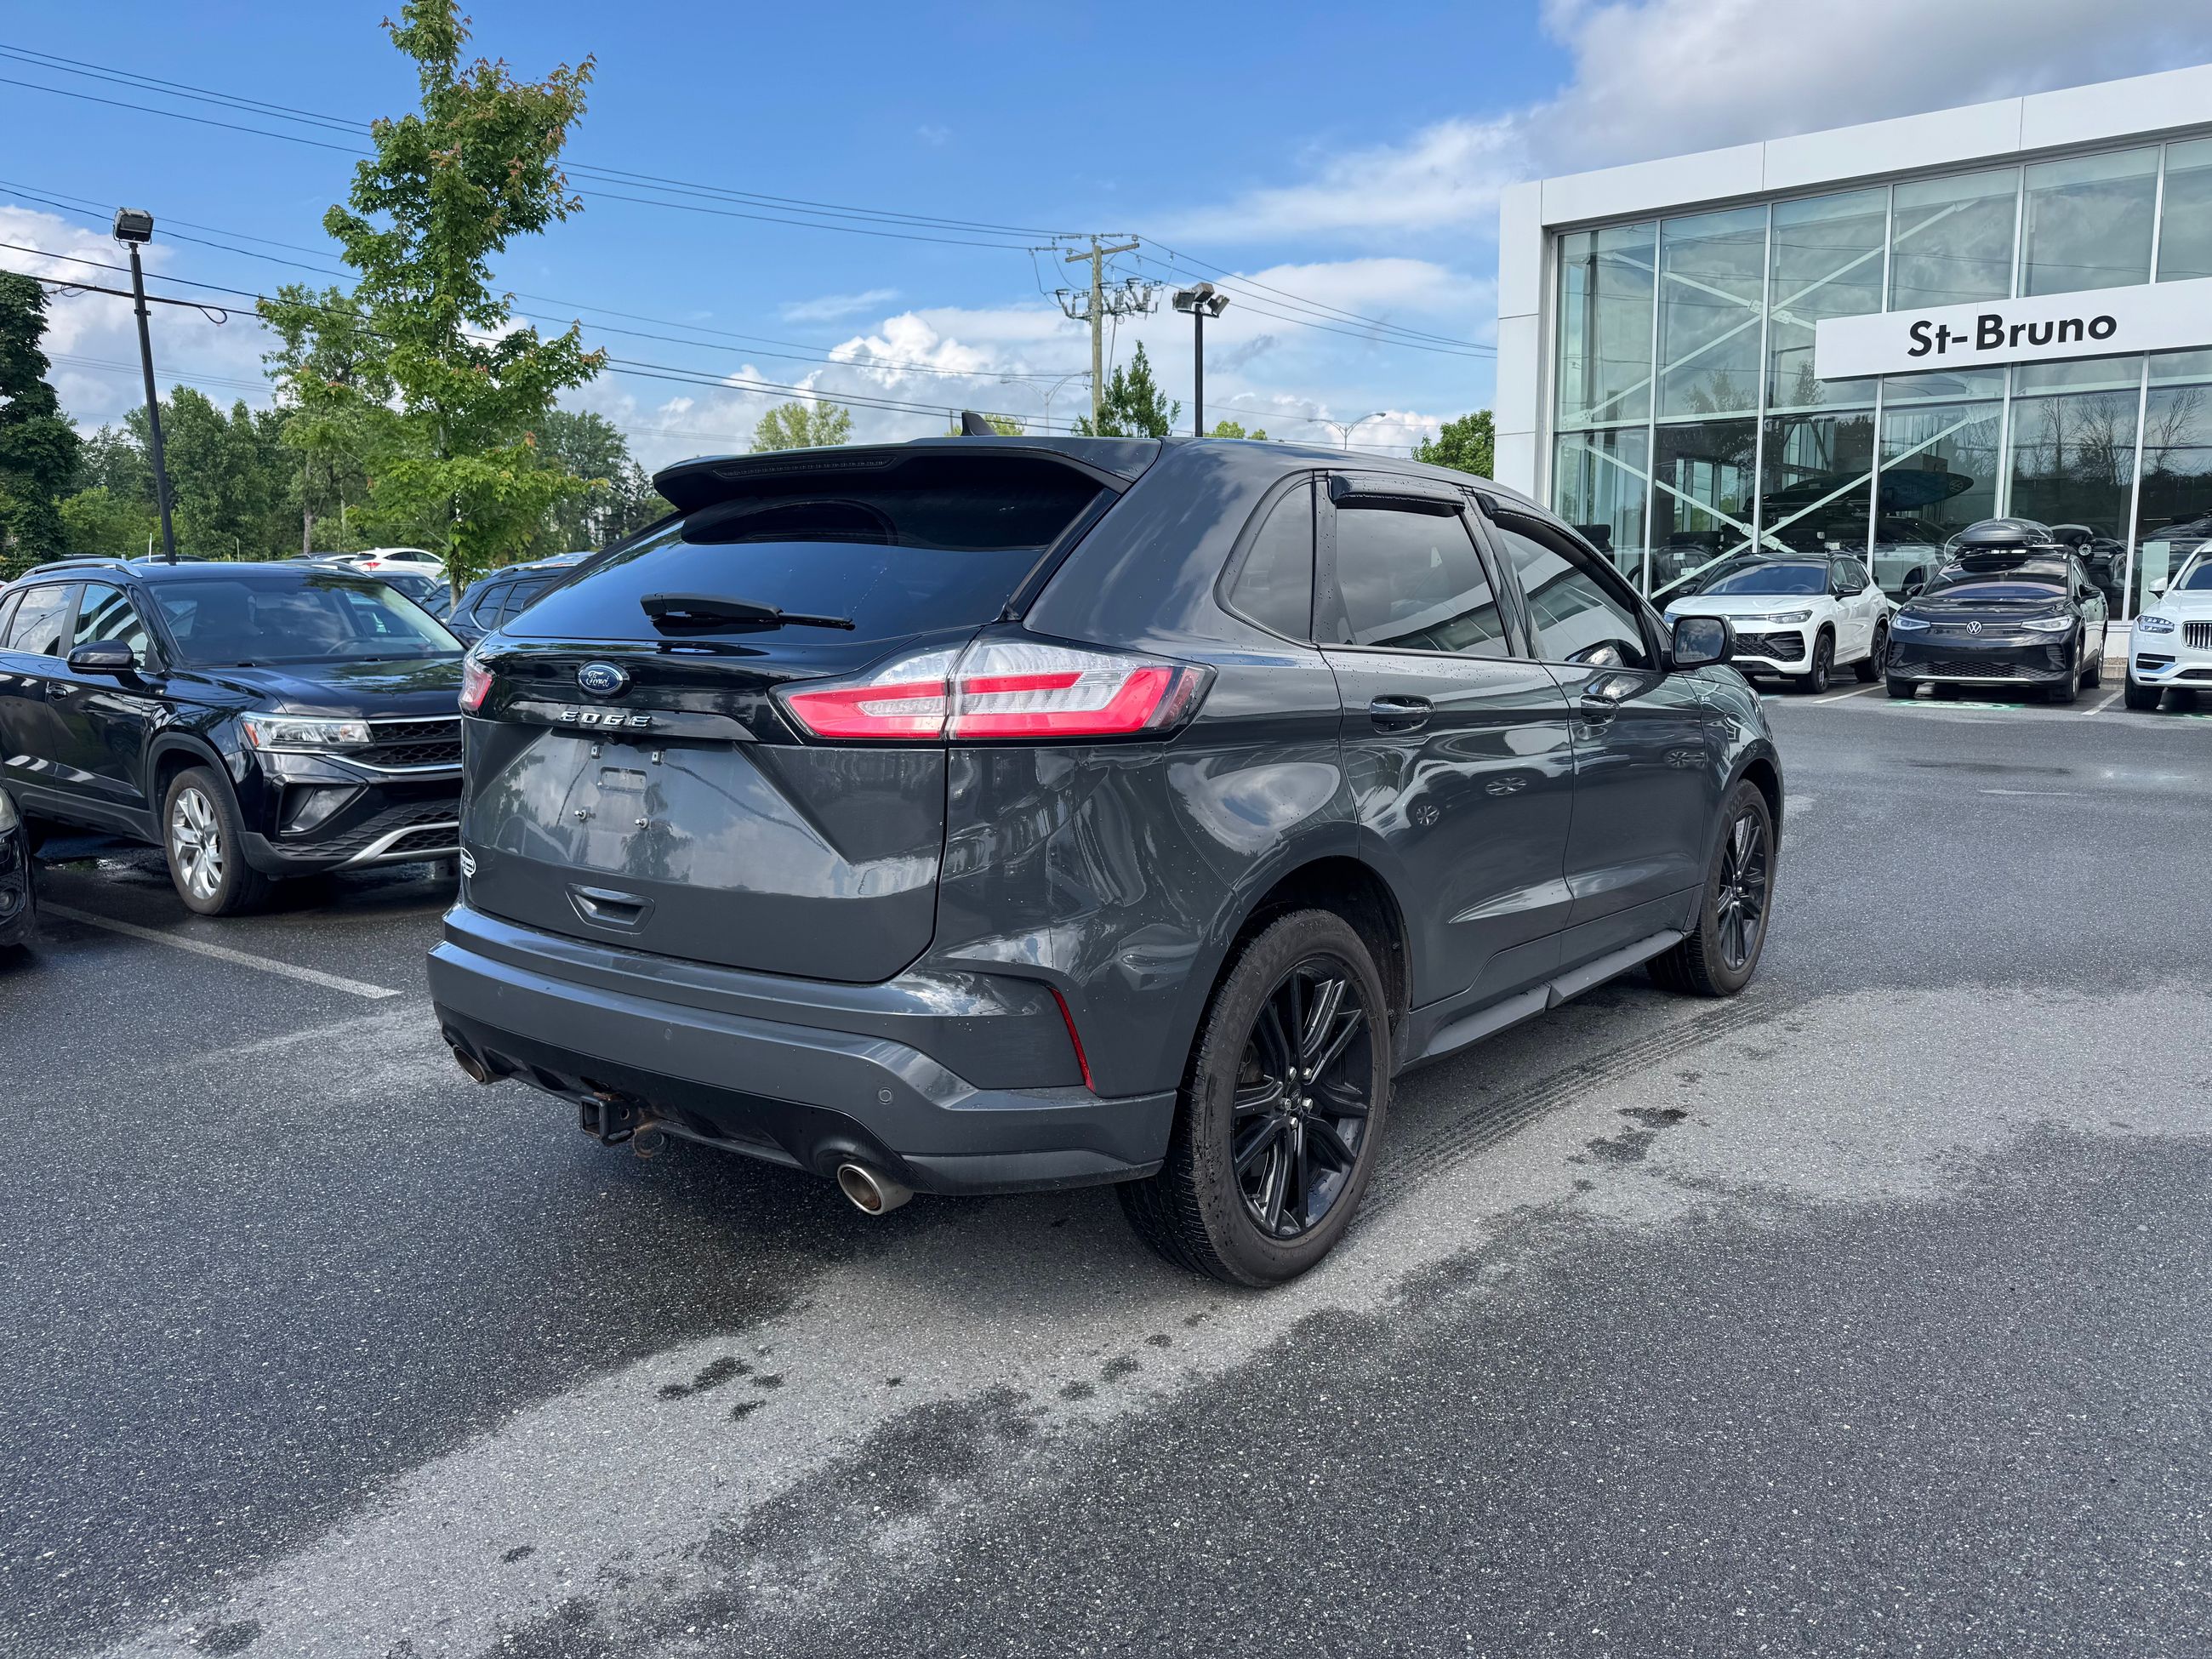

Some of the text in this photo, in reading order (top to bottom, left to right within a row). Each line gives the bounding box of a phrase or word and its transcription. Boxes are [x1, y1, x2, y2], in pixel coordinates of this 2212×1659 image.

[1907, 313, 2118, 357] St-Bruno
[585, 670, 610, 687] Ford
[559, 710, 653, 727] EDGE
